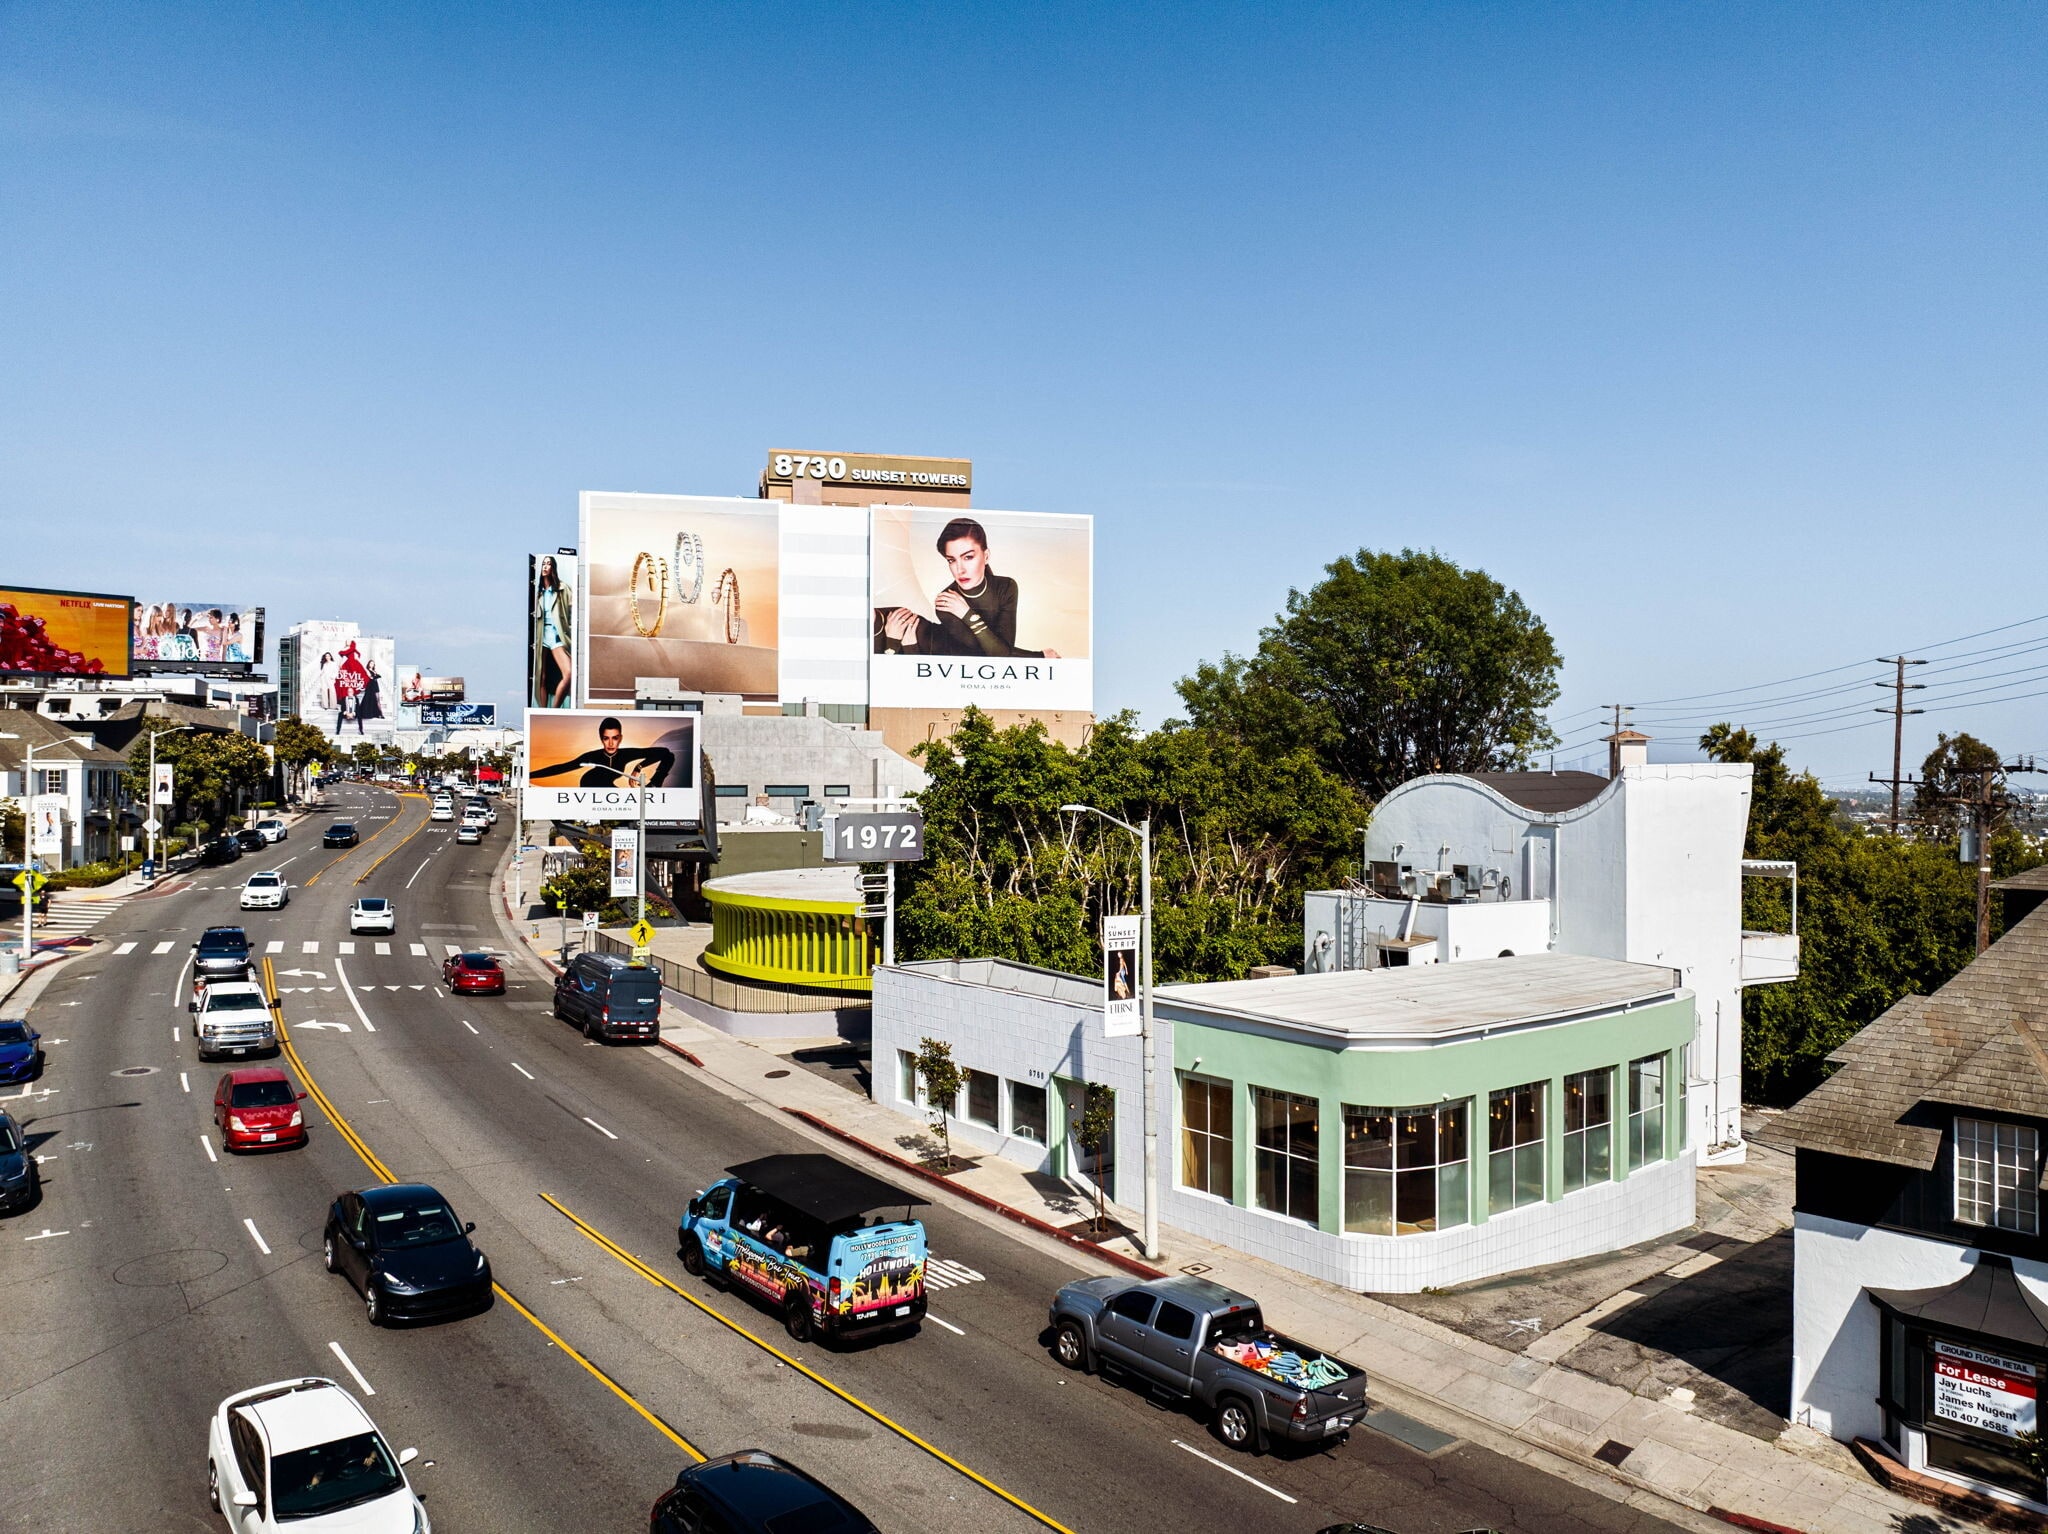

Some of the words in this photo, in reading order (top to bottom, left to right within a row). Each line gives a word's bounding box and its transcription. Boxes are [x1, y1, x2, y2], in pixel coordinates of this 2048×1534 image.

[774, 455, 847, 480] 8730
[851, 468, 907, 483] SUNSET
[910, 471, 967, 486] TOWERS
[60, 599, 91, 609] NETFLIX
[336, 672, 363, 681] DEVIL
[916, 662, 1053, 681] BVLGARI
[841, 824, 917, 849] 1972
[1108, 929, 1136, 937] SUNSET
[1108, 940, 1136, 949] STRIP
[850, 1233, 917, 1252] HOLLYWOODBUSTOURS.COM
[767, 1255, 783, 1273] Bus
[782, 1263, 803, 1283] Tours
[859, 1253, 917, 1280] HOLLYWOOD
[1941, 1344, 1974, 1359] GROUND
[1975, 1353, 2001, 1366] FLOOR
[2002, 1360, 2030, 1374] RETAIL
[1938, 1361, 1961, 1377] For
[1964, 1369, 2007, 1390] Lease
[1938, 1377, 1958, 1391] Jay
[1960, 1383, 1992, 1399] Luchs
[1938, 1392, 1974, 1409] James
[1977, 1402, 2017, 1422] Nugent
[1939, 1407, 1958, 1419] 310
[1960, 1413, 1979, 1425] 407
[1982, 1419, 2009, 1434] 6585
